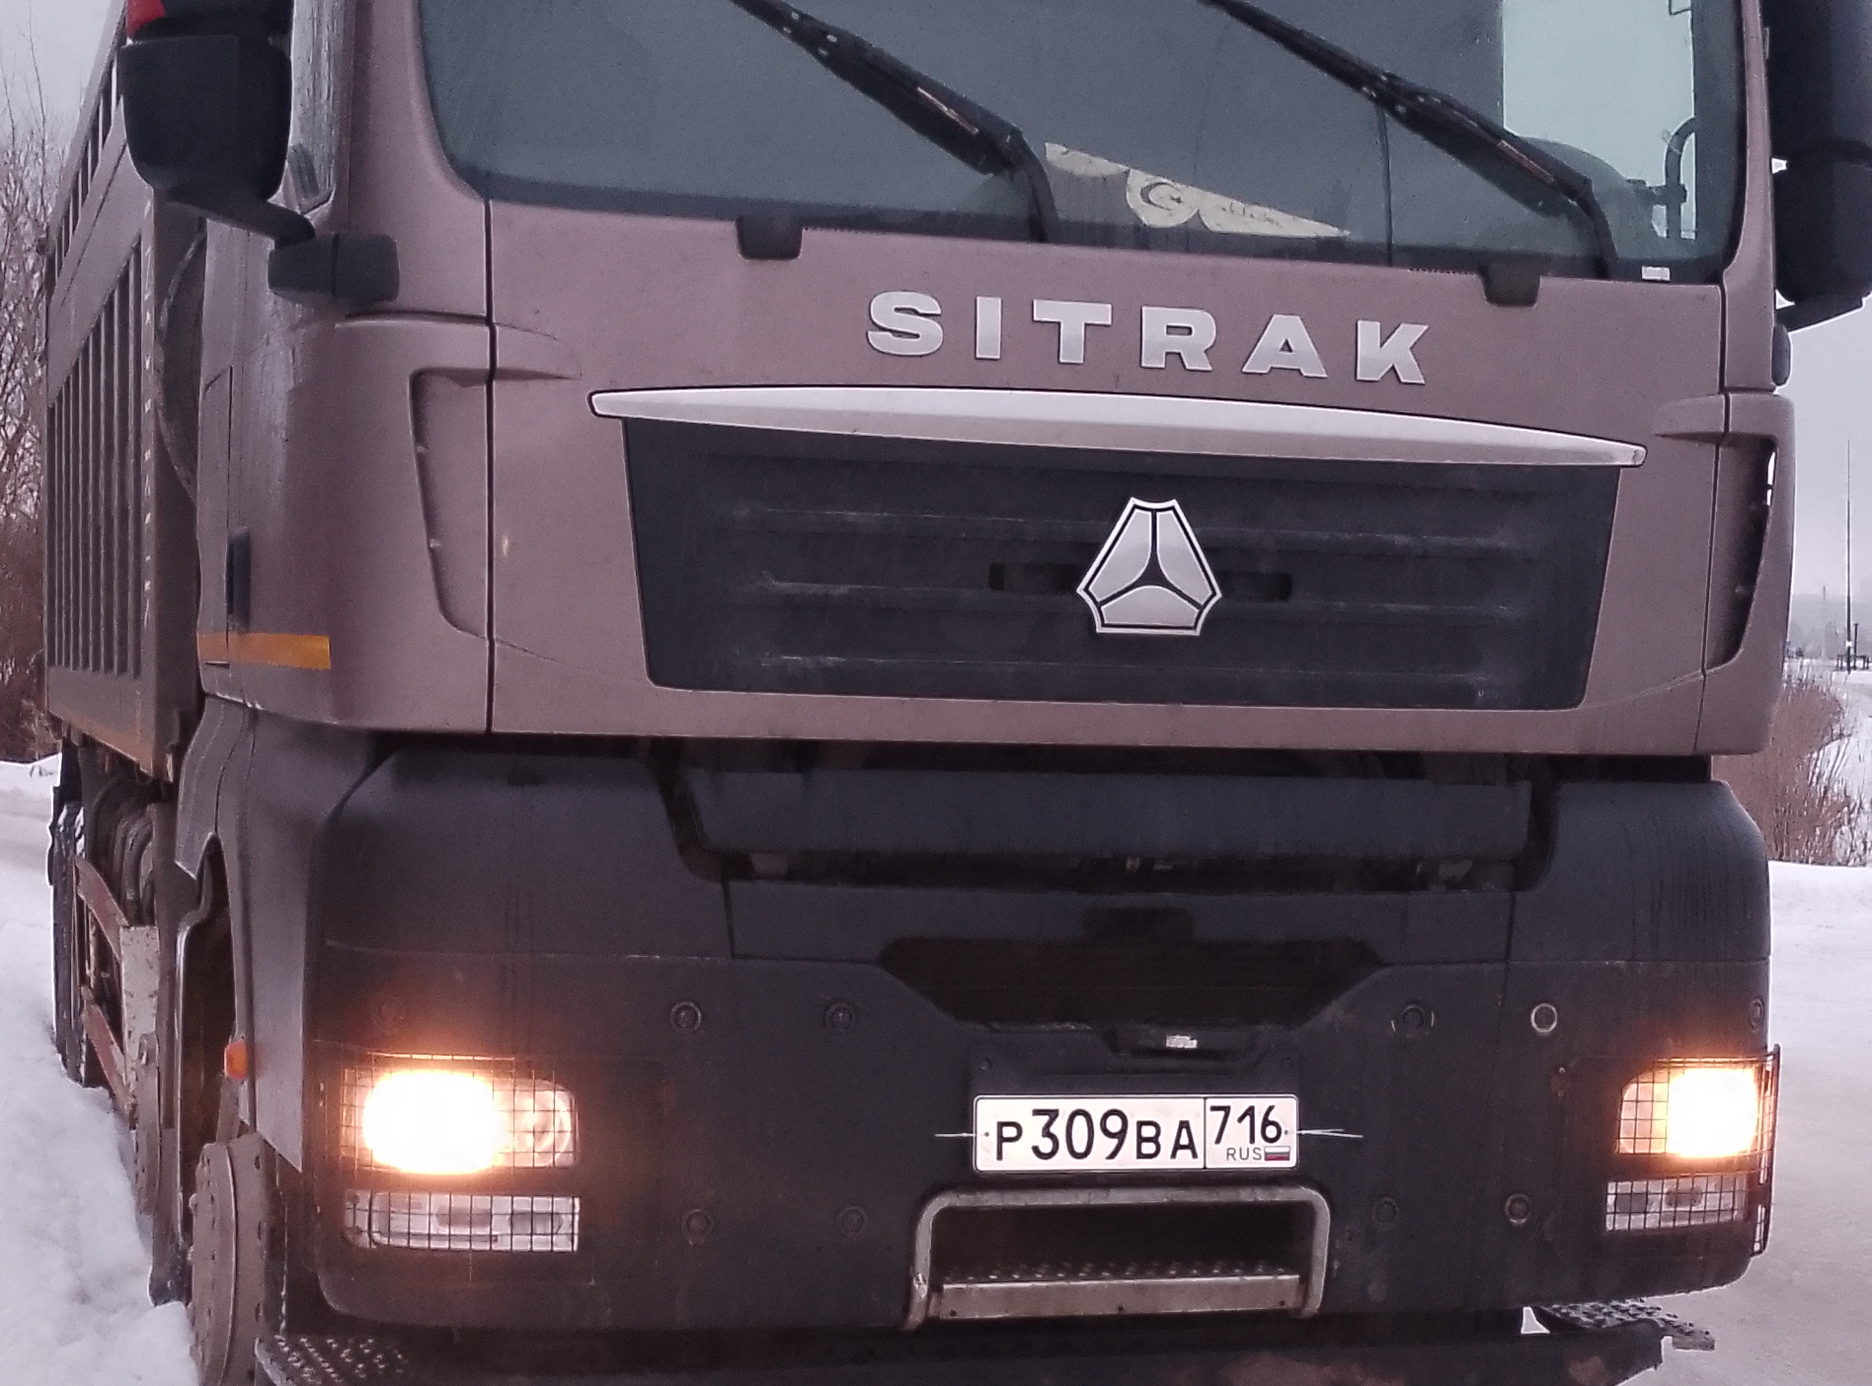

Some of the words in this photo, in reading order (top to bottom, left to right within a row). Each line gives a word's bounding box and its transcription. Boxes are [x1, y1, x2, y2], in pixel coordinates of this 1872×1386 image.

[866, 290, 1429, 385] SITRAK
[1209, 1105, 1283, 1145] 716
[1226, 1146, 1263, 1161] RUS
